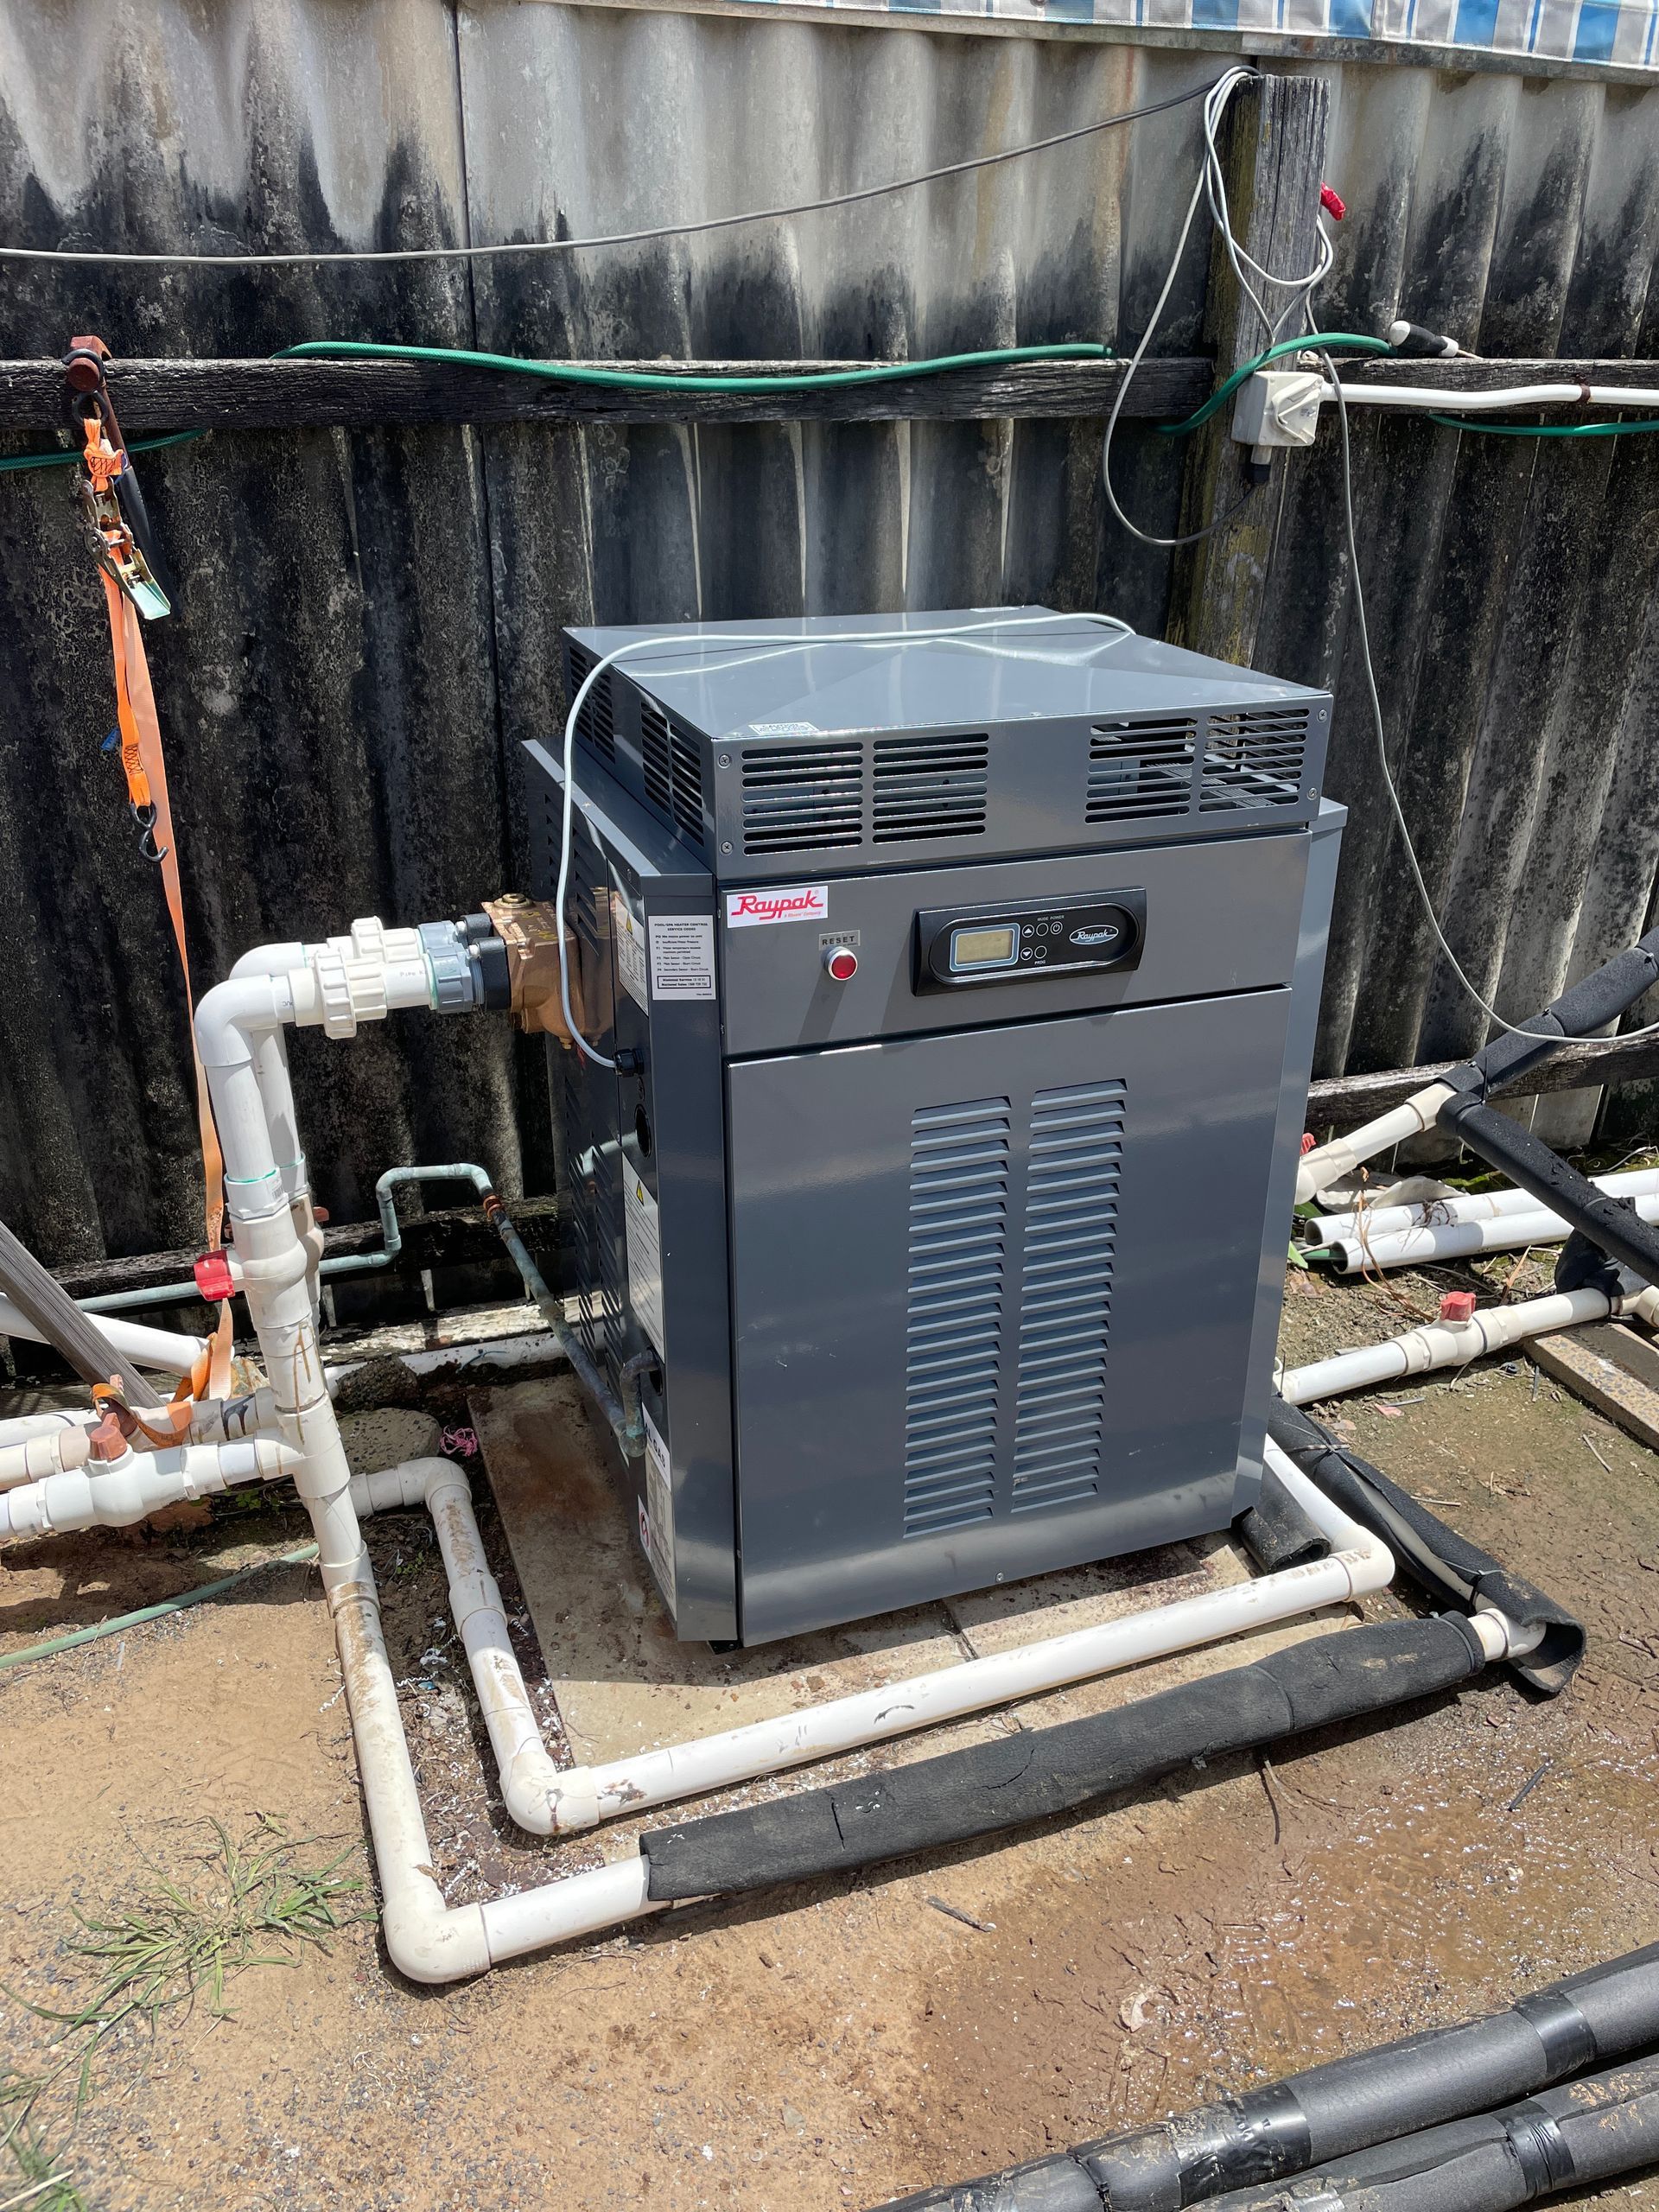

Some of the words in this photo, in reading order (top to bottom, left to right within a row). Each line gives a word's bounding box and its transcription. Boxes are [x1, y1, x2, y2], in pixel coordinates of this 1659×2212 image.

[731, 890, 823, 920] Raypak
[822, 935, 855, 945] RESET
[1077, 929, 1109, 942] Raypak
[652, 1437, 666, 1468] GAS
